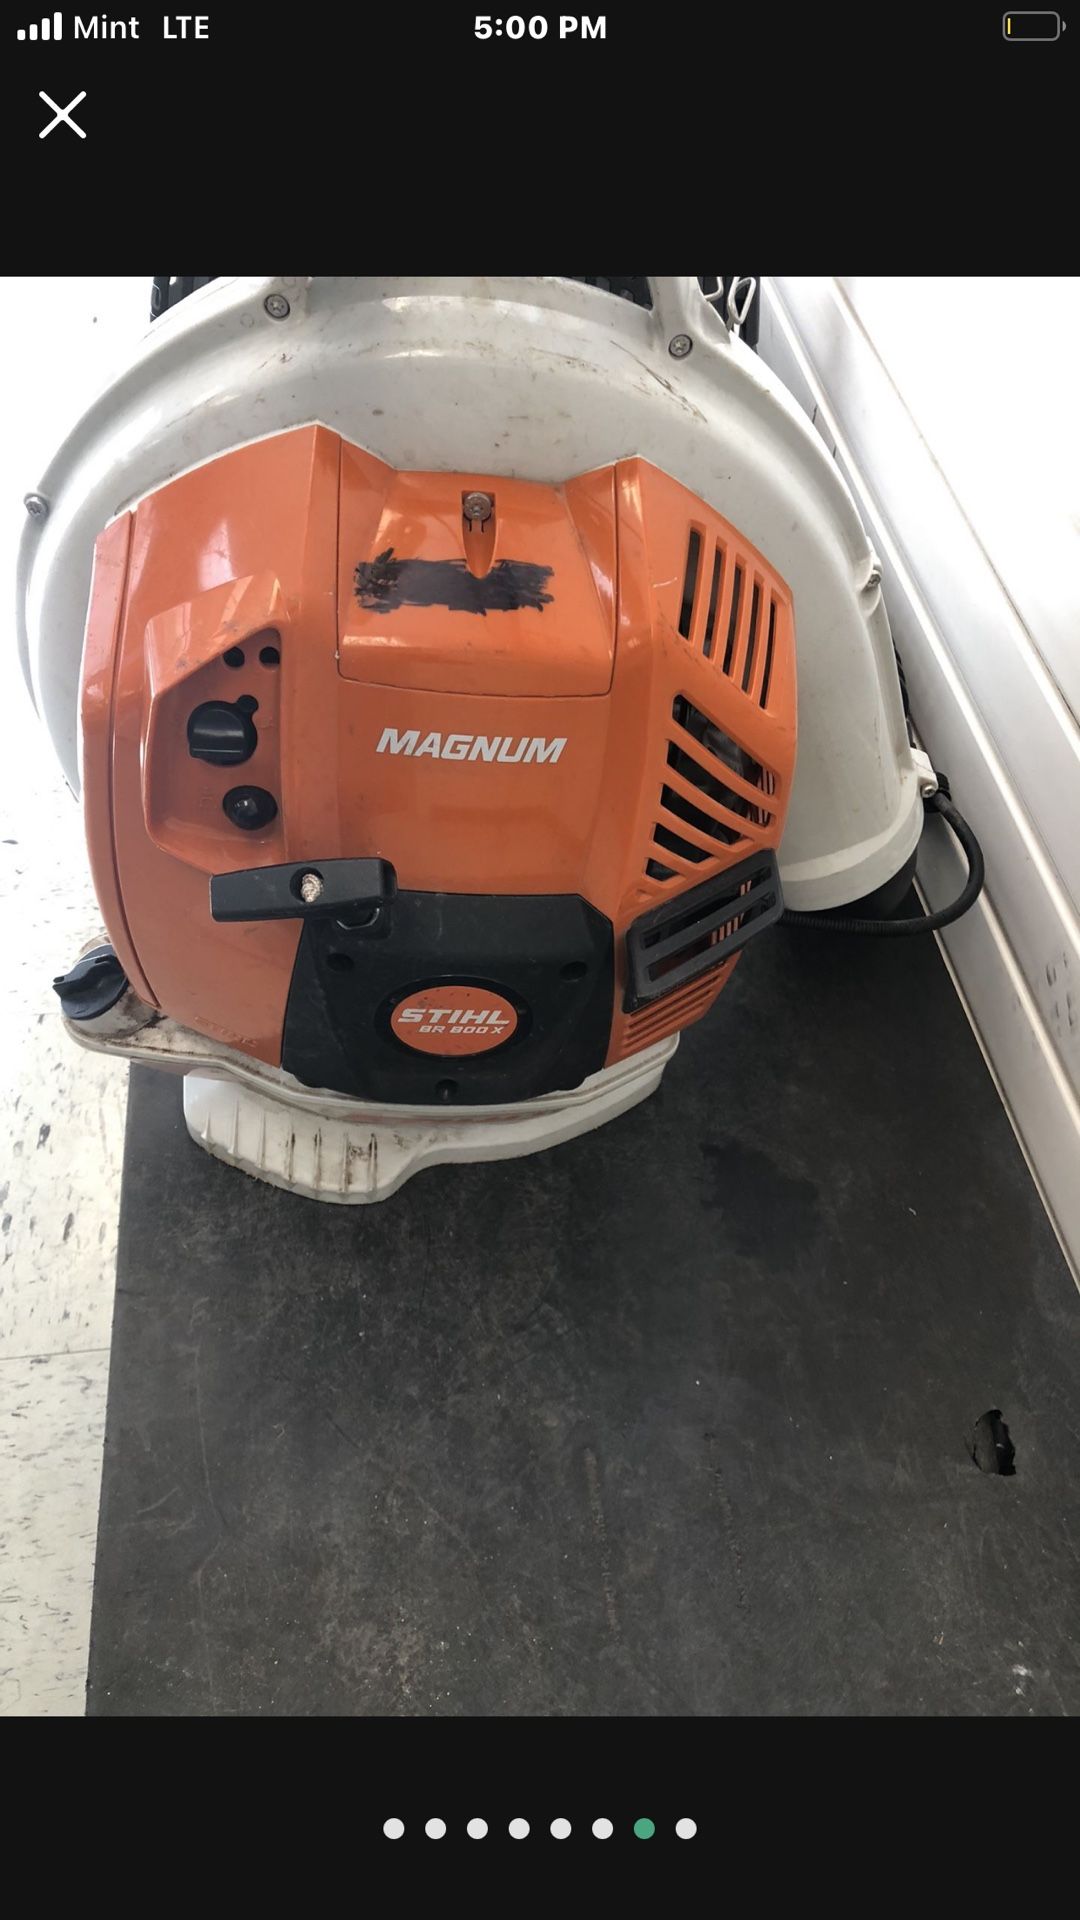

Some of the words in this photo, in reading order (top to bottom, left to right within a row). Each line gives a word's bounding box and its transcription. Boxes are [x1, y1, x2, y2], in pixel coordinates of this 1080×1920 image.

[376, 727, 568, 764] MAGNUM
[397, 1007, 510, 1025] STIHL
[418, 1025, 445, 1034] BR
[449, 1025, 488, 1034] 800
[490, 1026, 505, 1034] X
